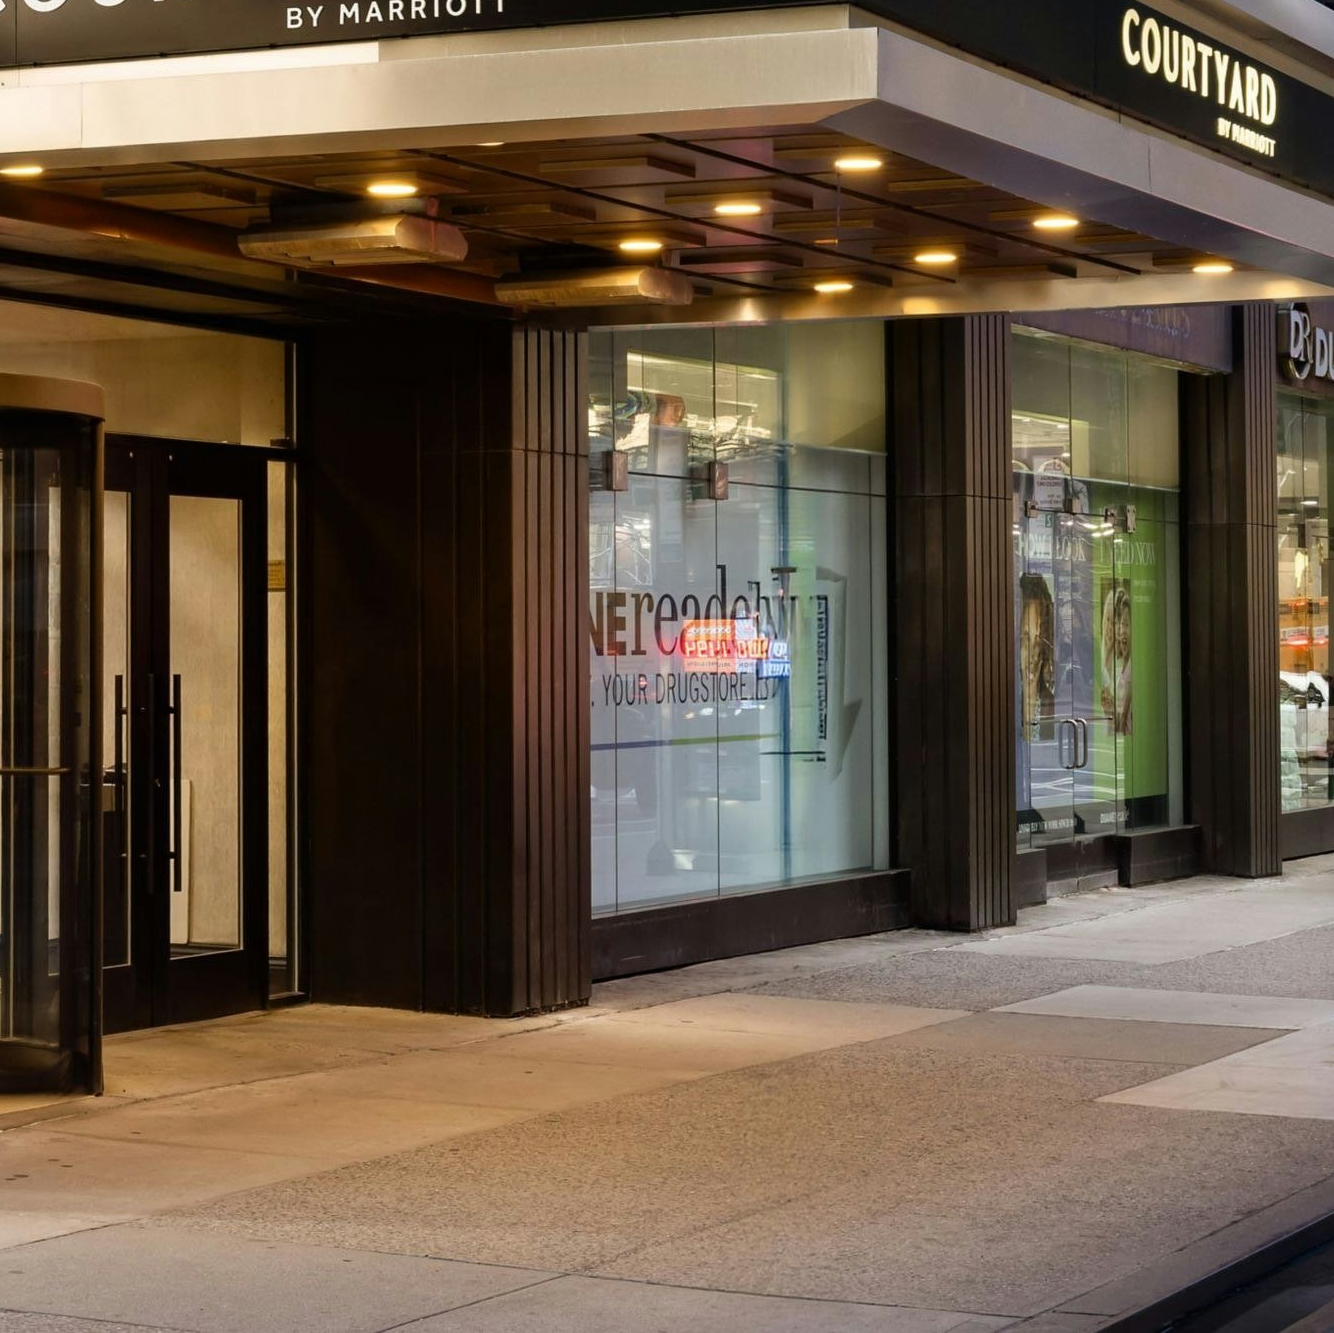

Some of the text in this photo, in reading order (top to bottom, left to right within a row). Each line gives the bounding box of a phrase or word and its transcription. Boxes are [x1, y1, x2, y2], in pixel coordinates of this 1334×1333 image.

[286, 5, 323, 30] BY
[1122, 8, 1277, 126] COURTYARD
[1217, 117, 1276, 158] BY MARRIOTT
[602, 674, 649, 707] YOUR
